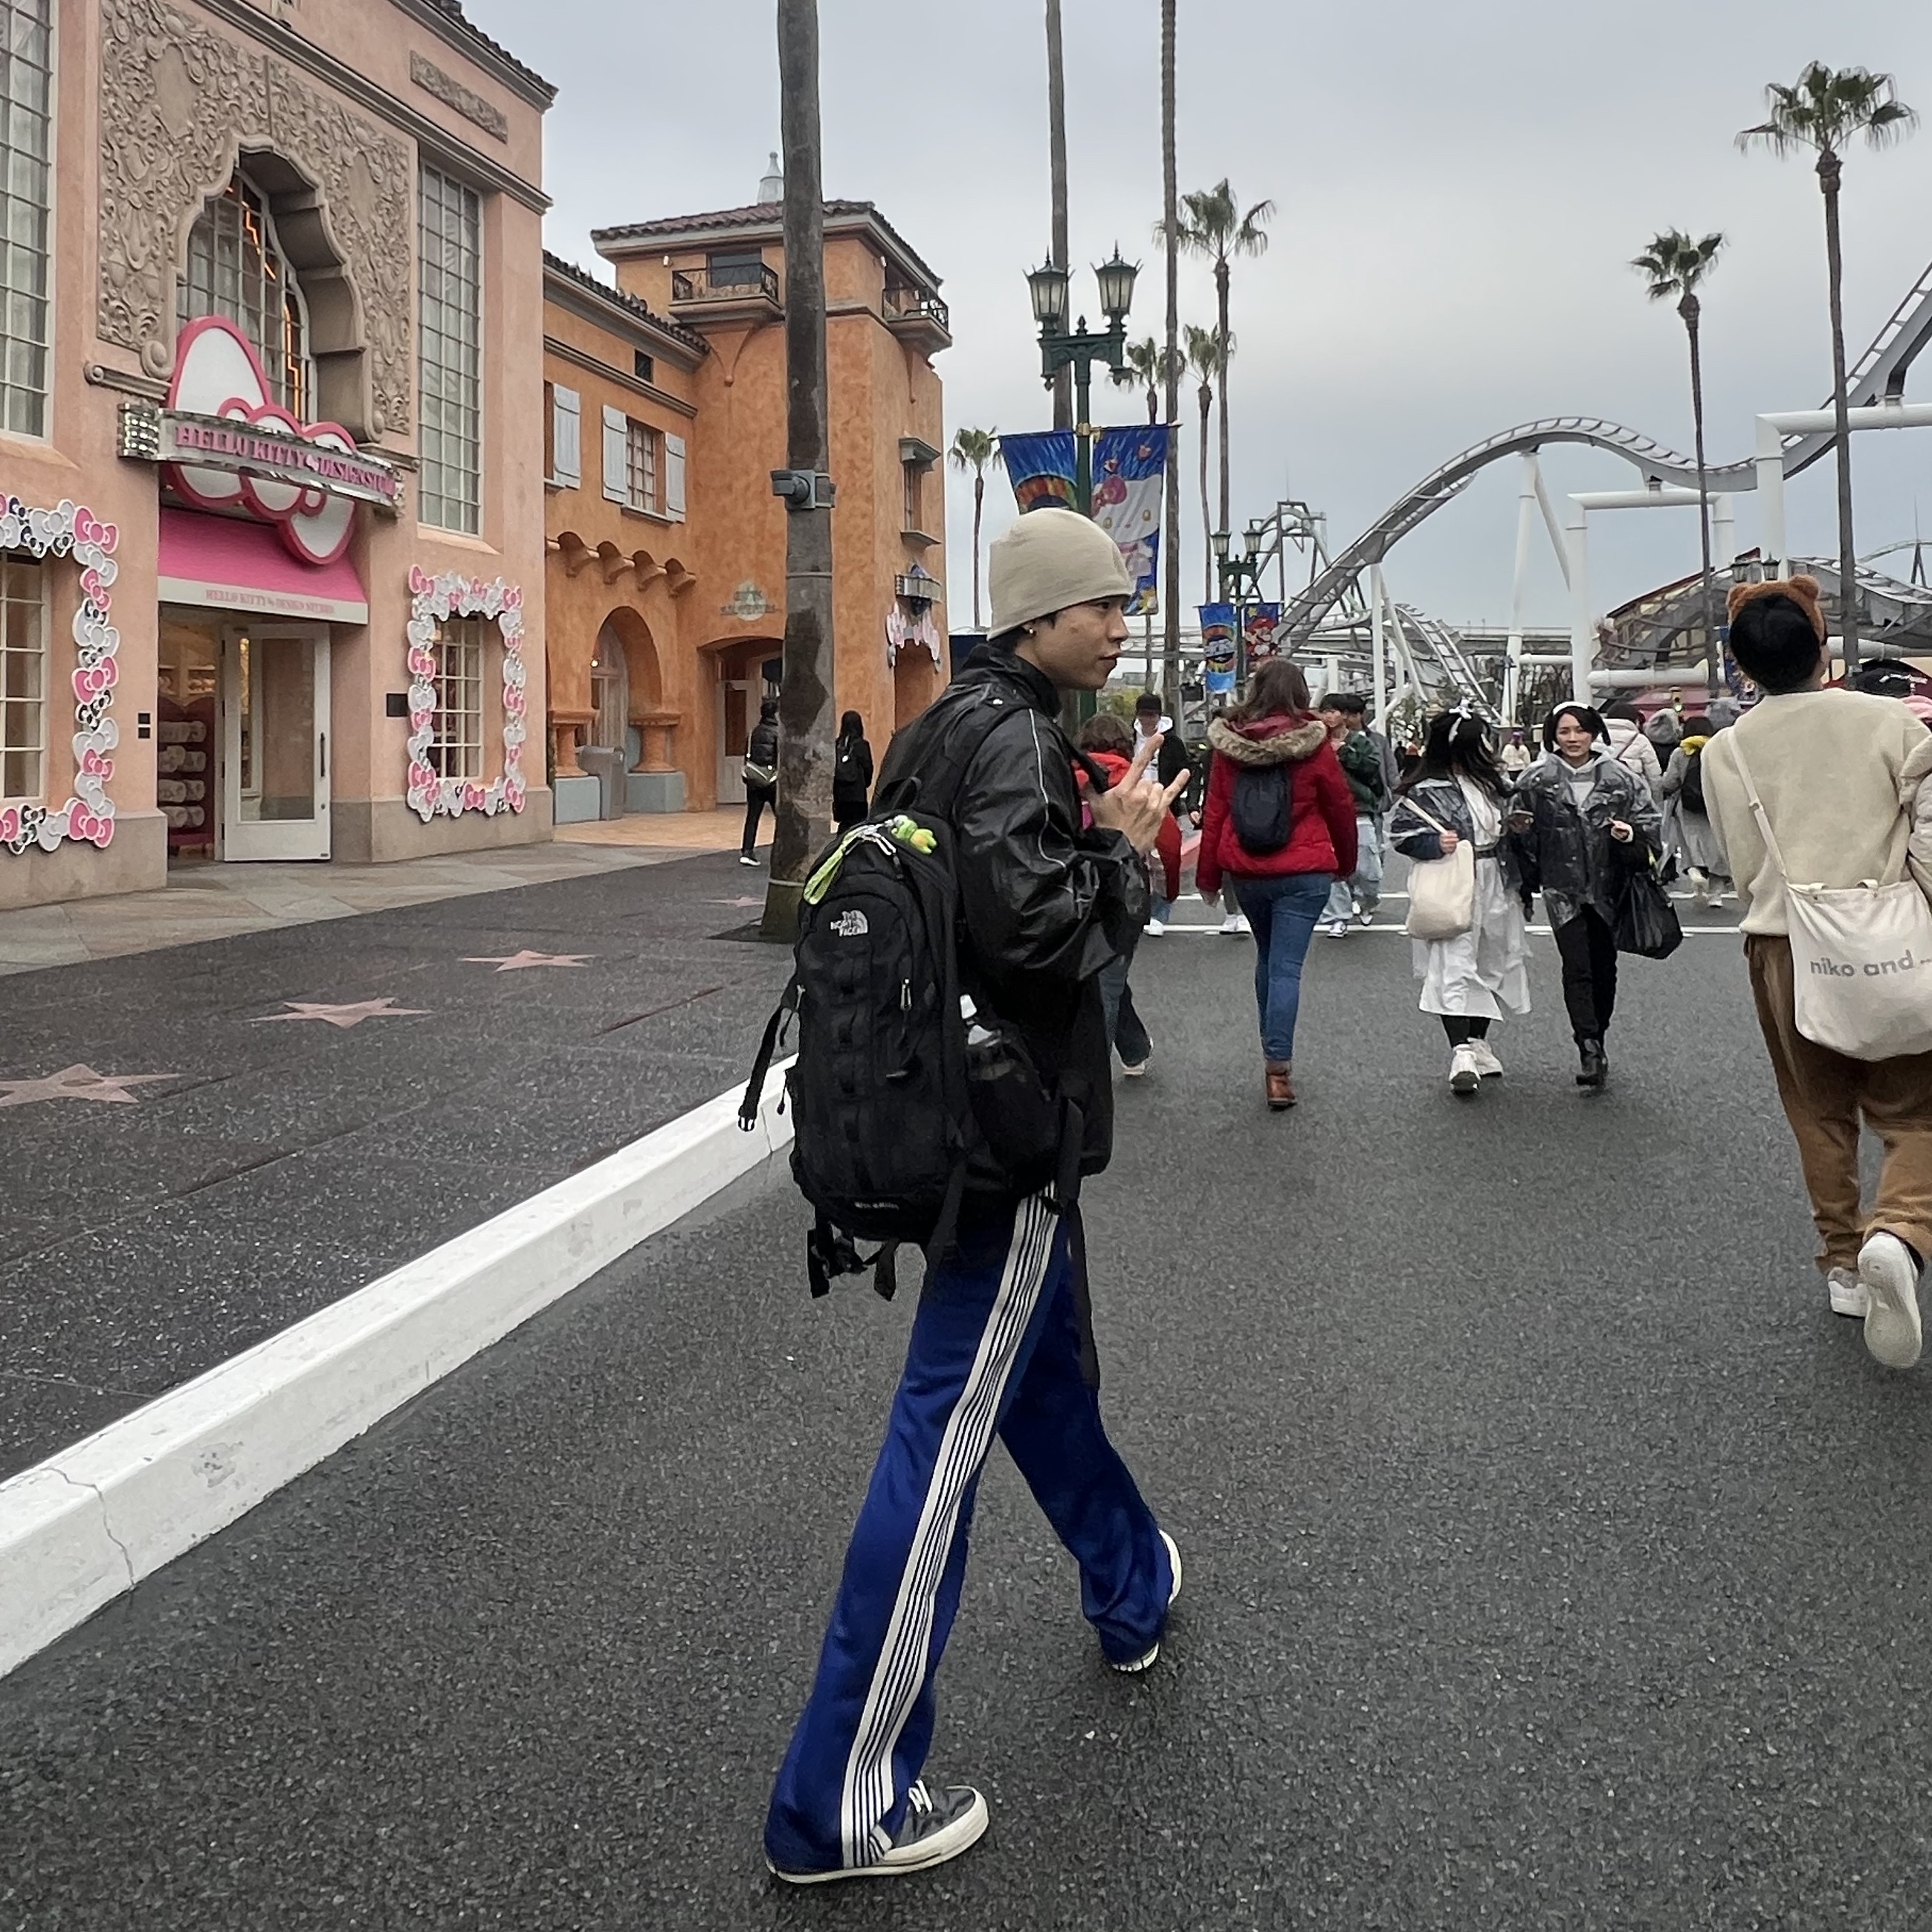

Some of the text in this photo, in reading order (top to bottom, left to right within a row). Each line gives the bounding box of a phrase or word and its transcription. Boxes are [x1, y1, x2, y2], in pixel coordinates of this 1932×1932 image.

[175, 426, 248, 456] HELLO
[253, 440, 306, 469] KITTY
[205, 589, 237, 602] HELLO
[239, 593, 265, 606] KITTY
[1810, 949, 1914, 977] niko and
